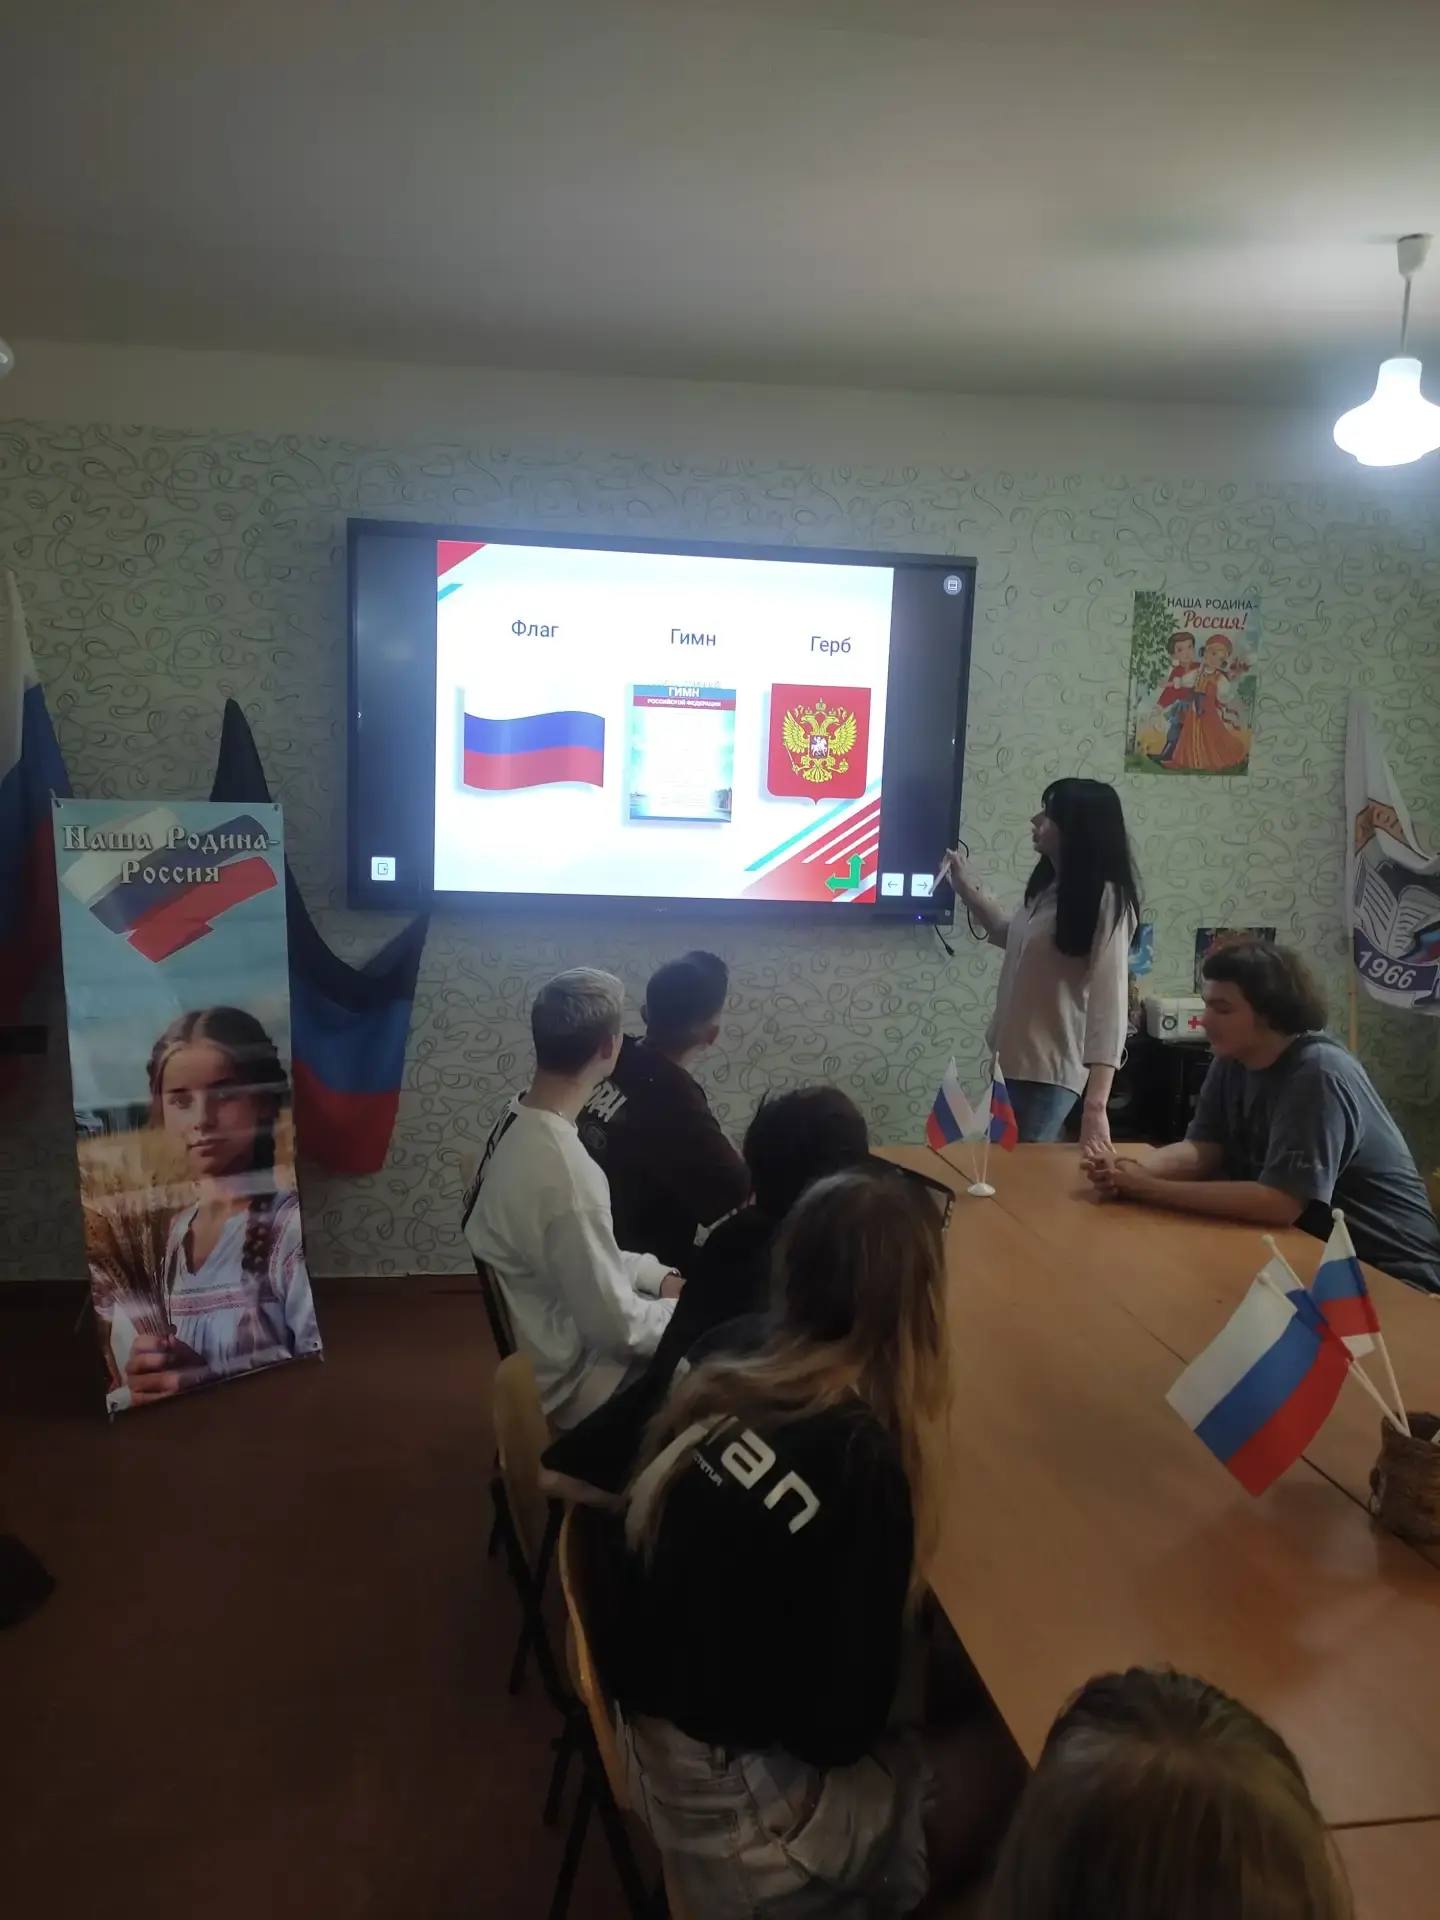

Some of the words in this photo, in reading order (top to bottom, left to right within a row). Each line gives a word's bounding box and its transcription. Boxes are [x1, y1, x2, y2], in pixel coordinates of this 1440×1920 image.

[1167, 597, 1202, 609] НАША
[511, 619, 559, 638] Флаг
[1183, 609, 1248, 631] Россия!
[670, 628, 716, 647] Гимн
[810, 635, 851, 656] Герб
[668, 686, 700, 698] ГИМН
[62, 824, 154, 850] Наша
[119, 860, 221, 884] Россия
[1358, 951, 1417, 989] 1966
